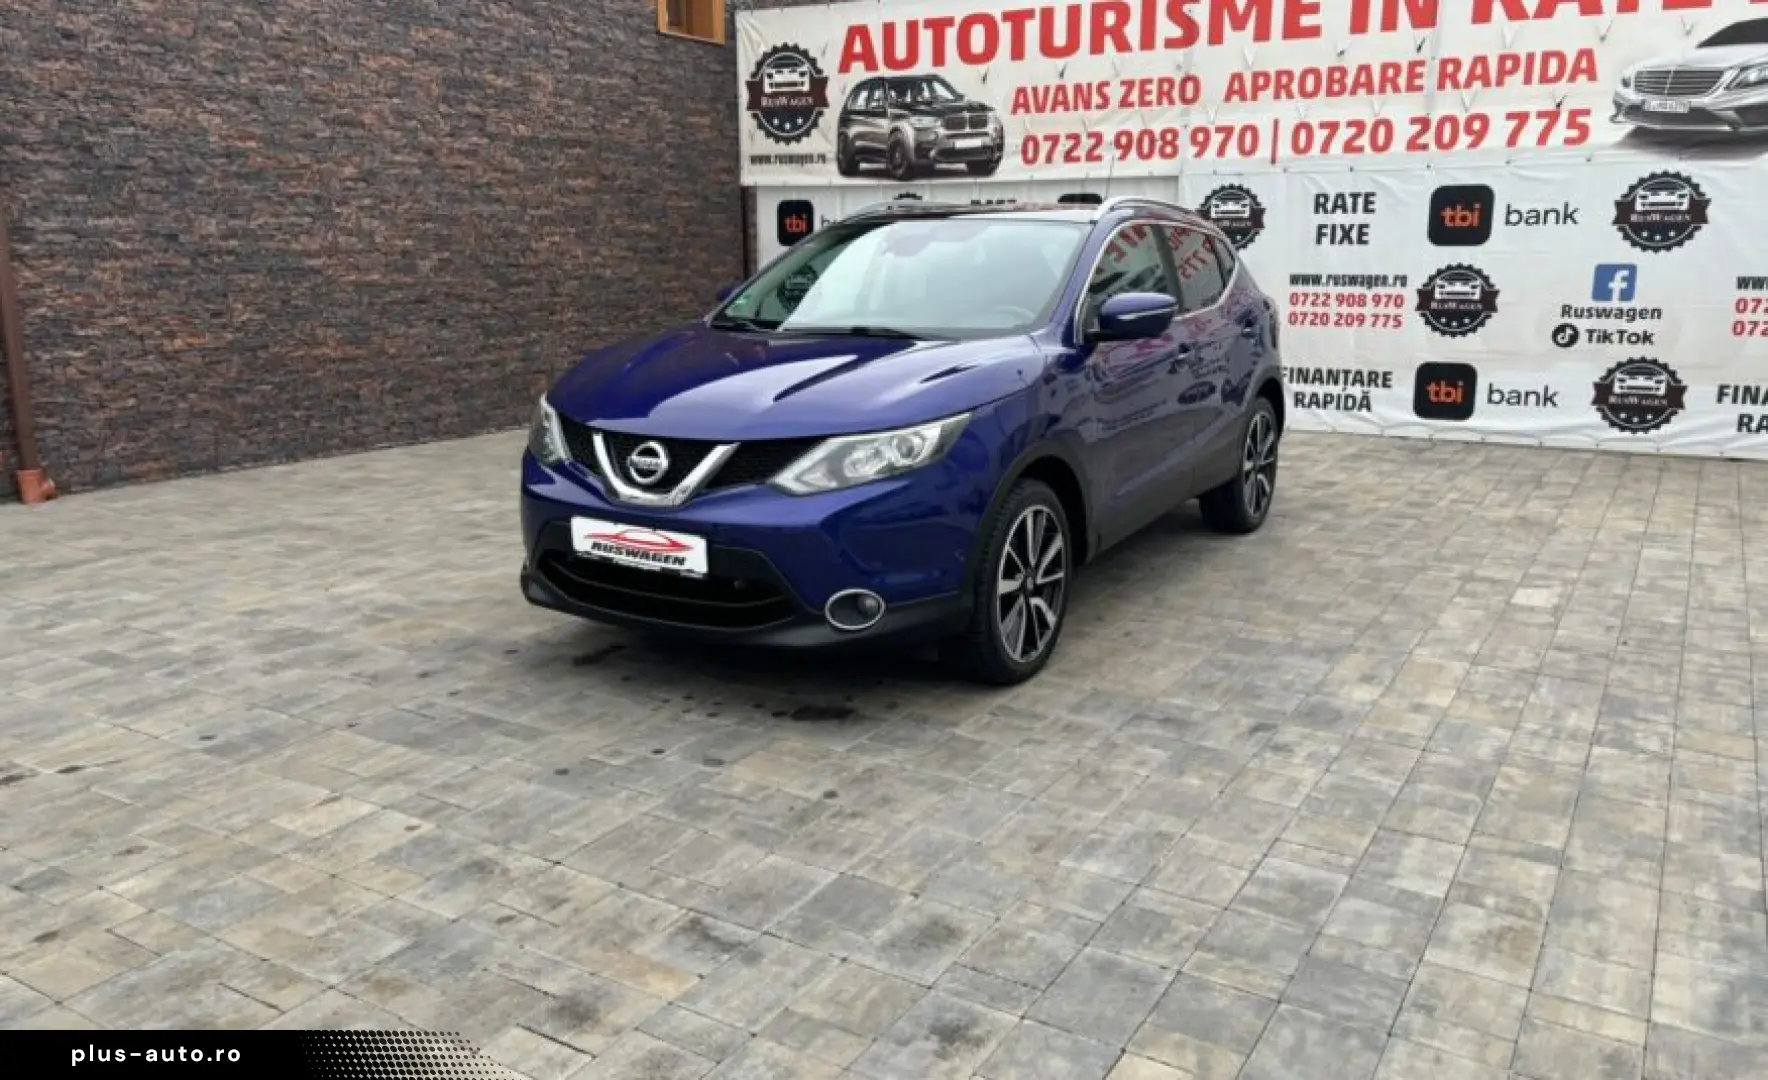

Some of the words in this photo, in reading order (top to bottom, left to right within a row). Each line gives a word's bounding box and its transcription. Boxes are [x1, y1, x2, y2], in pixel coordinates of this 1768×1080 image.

[838, 0, 1322, 74] AUTOTURISME
[1011, 81, 1110, 115] AVANS
[1118, 73, 1202, 109] ZERO
[1223, 60, 1427, 104] APROBARE
[1436, 48, 1598, 92] RAPIDA
[1021, 130, 1104, 166] 0722
[1113, 126, 1180, 162] 908
[1189, 124, 1260, 158] 970
[1290, 118, 1395, 156] 0720
[1406, 112, 1490, 153] 209
[1505, 108, 1592, 147] 775
[1313, 191, 1377, 215] RATE
[1440, 202, 1482, 228] tbi
[1504, 201, 1580, 227] bank
[1315, 223, 1371, 246] FIXE
[1289, 273, 1408, 290] www.ruswagen.ro
[1736, 276, 1768, 290] ww
[1289, 292, 1331, 307] 0722
[1335, 293, 1368, 308] 908
[1372, 293, 1405, 309] 970
[1288, 312, 1329, 326] 0720
[1334, 312, 1366, 328] 209
[1370, 313, 1404, 328] 775
[1561, 304, 1663, 323] Ruswagen
[1585, 328, 1656, 346] TikTok
[1293, 390, 1373, 412] RAPIDĂ
[1426, 380, 1465, 404] tbi
[1487, 382, 1559, 408] bank
